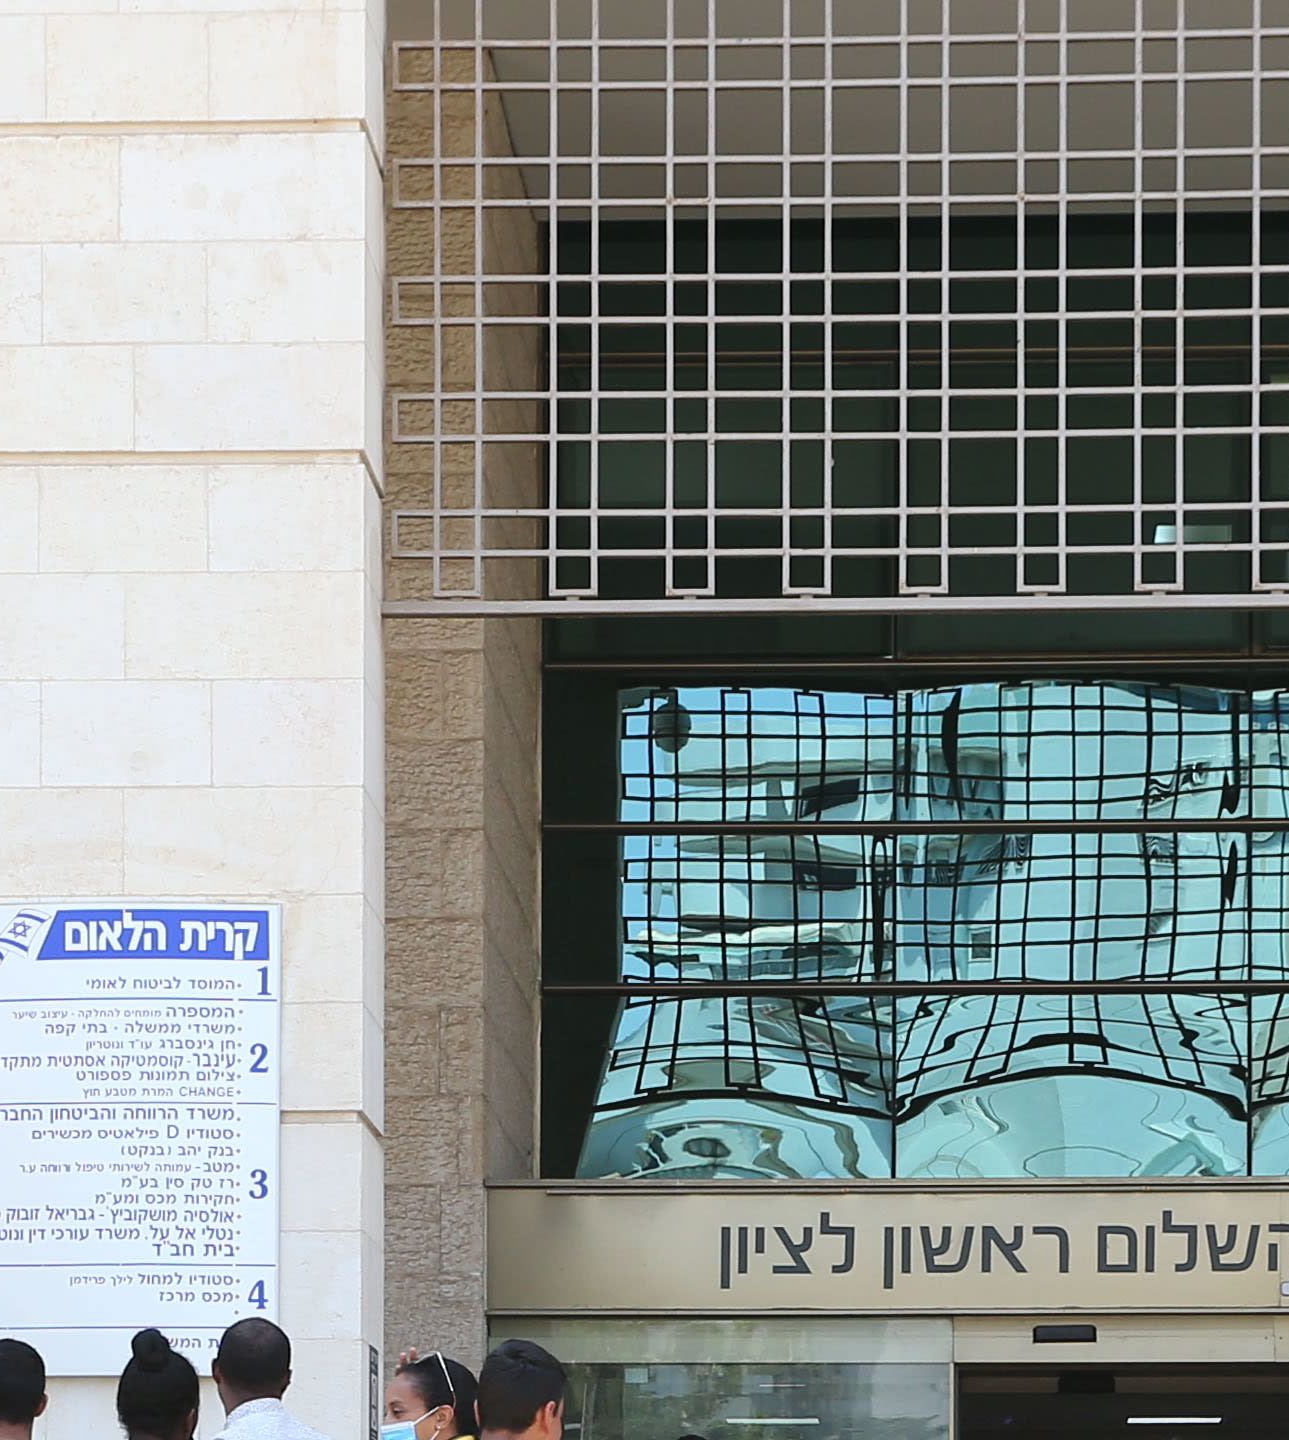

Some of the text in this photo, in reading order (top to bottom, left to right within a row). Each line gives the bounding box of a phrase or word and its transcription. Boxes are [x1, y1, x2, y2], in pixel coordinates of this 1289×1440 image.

[64, 909, 260, 961] קרית הלאום
[86, 976, 235, 990] המוסד לביטוח לאומי
[258, 966, 271, 995] 1
[166, 1007, 235, 1018] המספרה
[45, 1020, 235, 1036] משרדי ממשלה בתי קפה
[86, 1041, 123, 1051] ונוטריון
[160, 1039, 214, 1049] גינסברג
[221, 1040, 235, 1052] חן
[47, 1056, 105, 1067] אסתטית
[111, 1055, 183, 1069] קוסמטיקה
[192, 1051, 235, 1070] עינבר
[250, 1043, 268, 1072] 2
[76, 1067, 235, 1081] צילום תמונות פספורט
[179, 1086, 234, 1097] CHANGE
[50, 1108, 116, 1124] והביטחון
[123, 1108, 178, 1119] הרווחה
[186, 1108, 234, 1120] משרד
[32, 1125, 234, 1139] סטודיו D פילאטיס מכשירים
[178, 1146, 201, 1156] יהב
[208, 1146, 233, 1158] בנק
[203, 1162, 234, 1172] מטב
[166, 1177, 184, 1189] סין
[191, 1178, 212, 1191] טק
[219, 1178, 234, 1188] רז
[249, 1169, 268, 1199] 3
[145, 1194, 176, 1204] מכס
[184, 1194, 234, 1207] חקירות
[6, 1208, 40, 1224] זובוק
[46, 1205, 94, 1220] גבריאל
[29, 1229, 45, 1243] דין
[51, 1229, 89, 1241] עורכי
[95, 1228, 140, 1239] משרד
[175, 1225, 196, 1240] אל
[202, 1225, 233, 1240] נטלי
[203, 1244, 237, 1256] בית
[720, 1211, 855, 1290] לציון
[883, 1225, 1070, 1290] ראשון
[138, 1272, 182, 1285] למחול
[189, 1275, 233, 1285] סטודיו
[160, 1292, 233, 1302] מכס מרכז
[248, 1280, 268, 1309] 4
